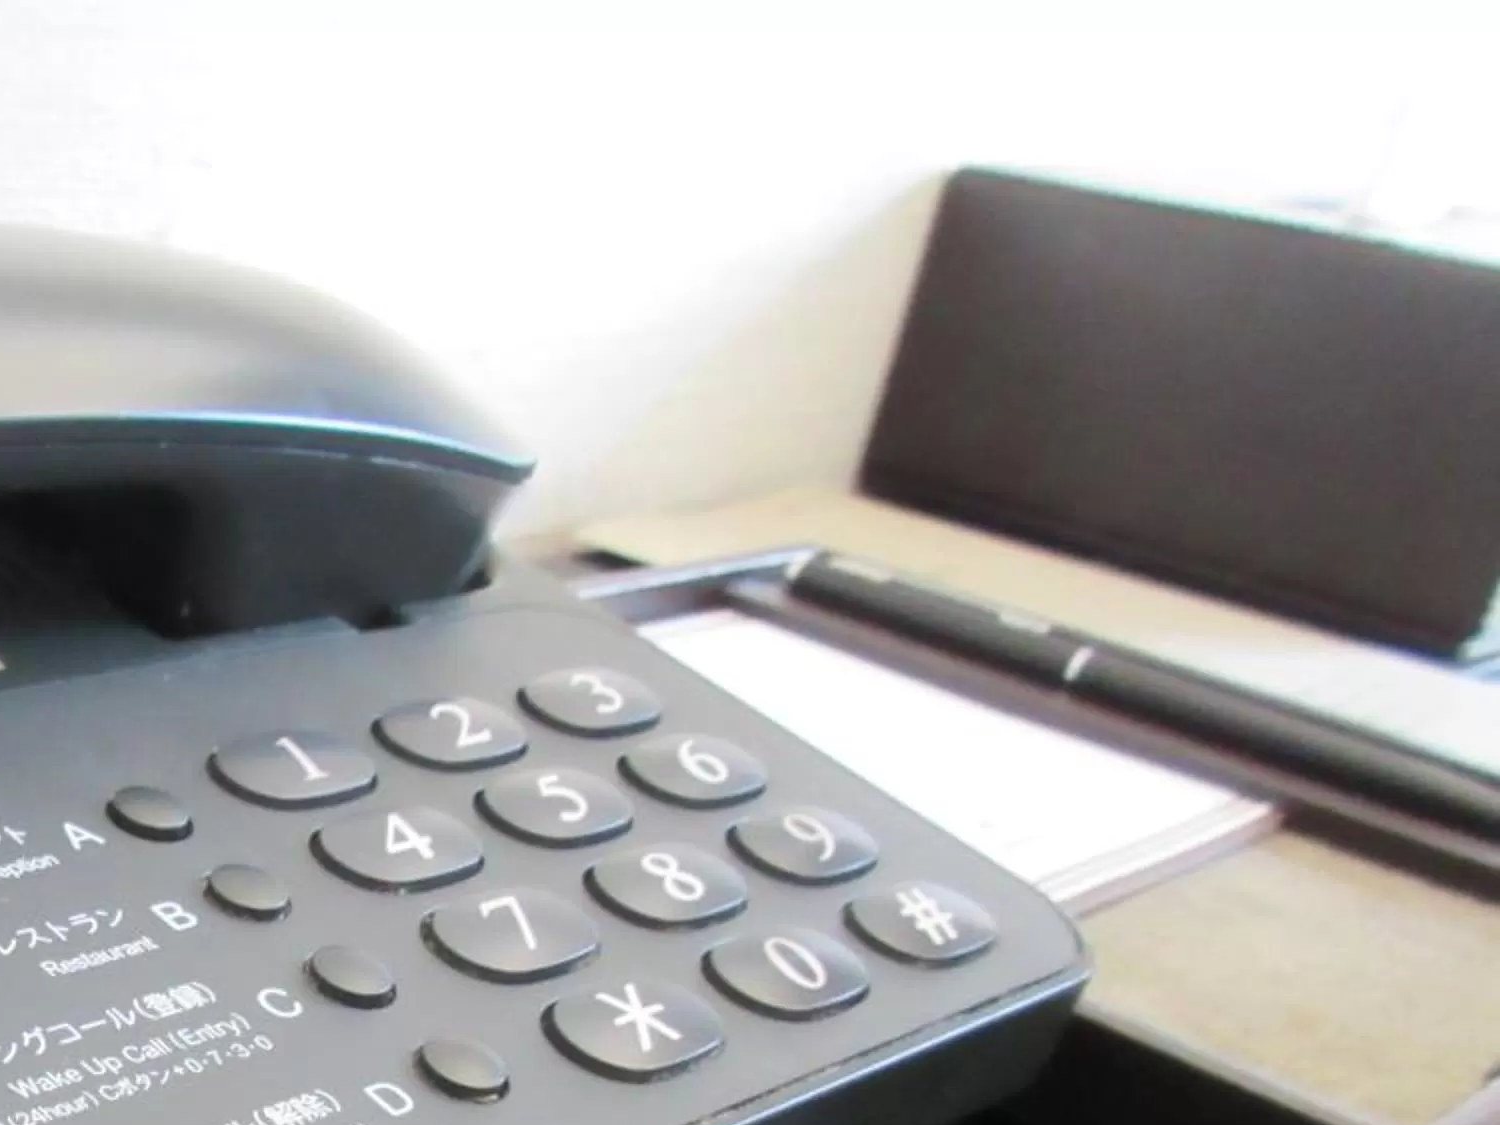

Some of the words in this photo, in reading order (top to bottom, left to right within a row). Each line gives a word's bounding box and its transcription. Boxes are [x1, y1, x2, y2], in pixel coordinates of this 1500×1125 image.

[570, 673, 623, 713] 3
[429, 702, 493, 748] 2
[275, 737, 330, 781] 1
[677, 740, 730, 783] 6
[538, 775, 588, 822] 5
[63, 820, 107, 852] A
[384, 814, 435, 861] 4
[783, 812, 836, 860] 9
[642, 852, 706, 901] 8
[150, 901, 200, 931] B
[479, 895, 539, 950] 7
[897, 887, 956, 946] #
[38, 935, 161, 978] Restaurant
[764, 935, 828, 991] 0
[257, 987, 303, 1018] C
[7, 1065, 84, 1100] Wake
[84, 1052, 124, 1079] Up
[364, 1082, 415, 1117] D
